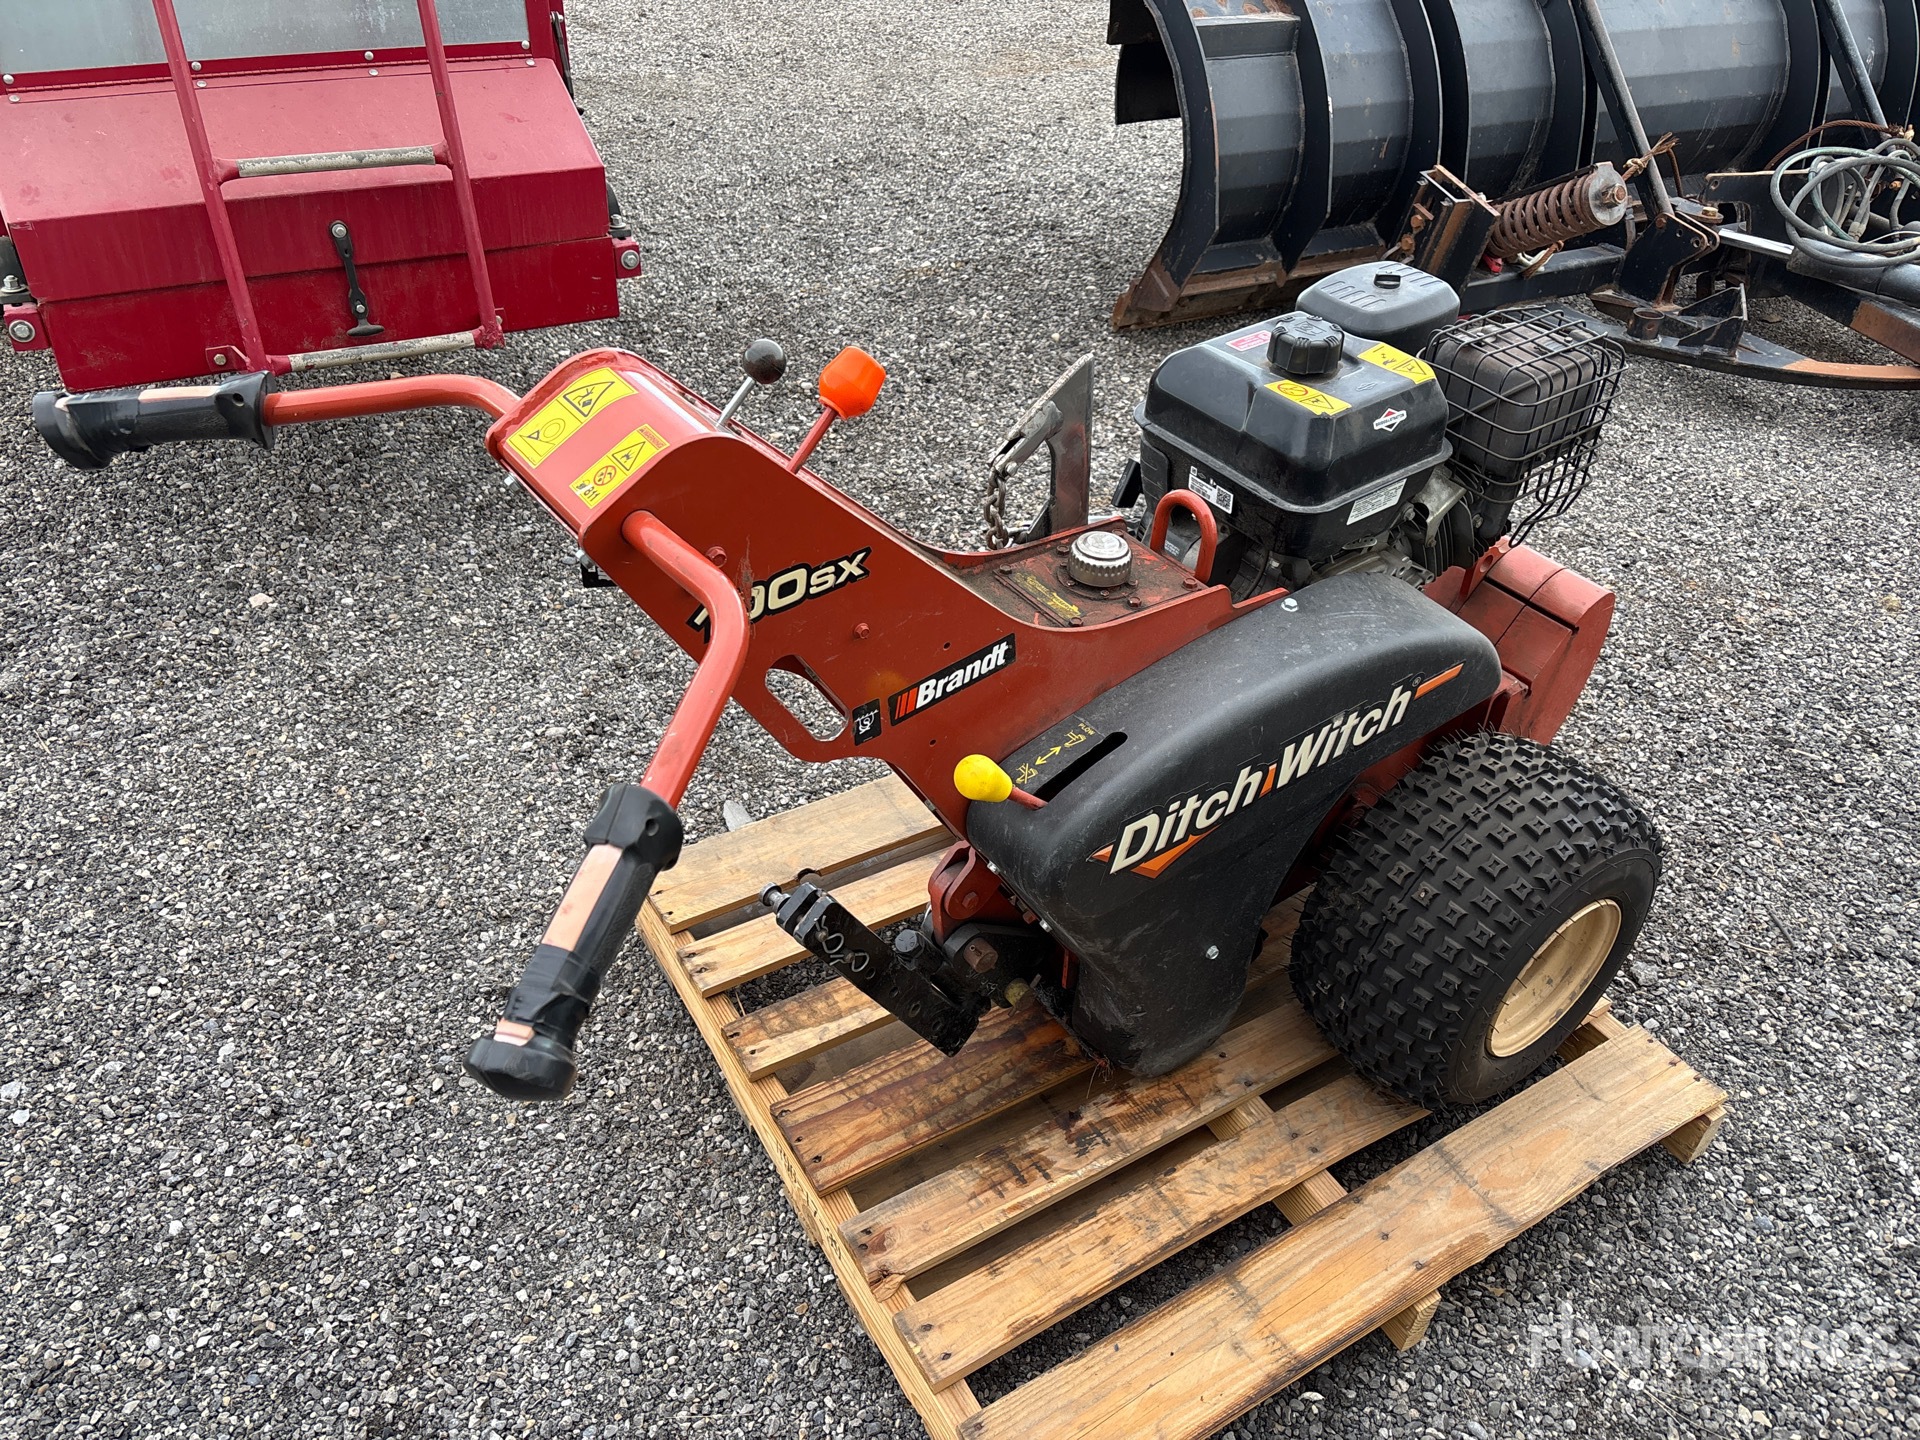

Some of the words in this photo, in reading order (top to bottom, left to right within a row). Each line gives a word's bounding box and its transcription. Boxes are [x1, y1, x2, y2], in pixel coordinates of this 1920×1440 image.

[583, 485, 600, 502] 811
[915, 640, 1010, 709] Brandt
[1078, 722, 1096, 736] PLOW
[1110, 765, 1263, 875] Ditch
[1275, 686, 1414, 789] Witch
